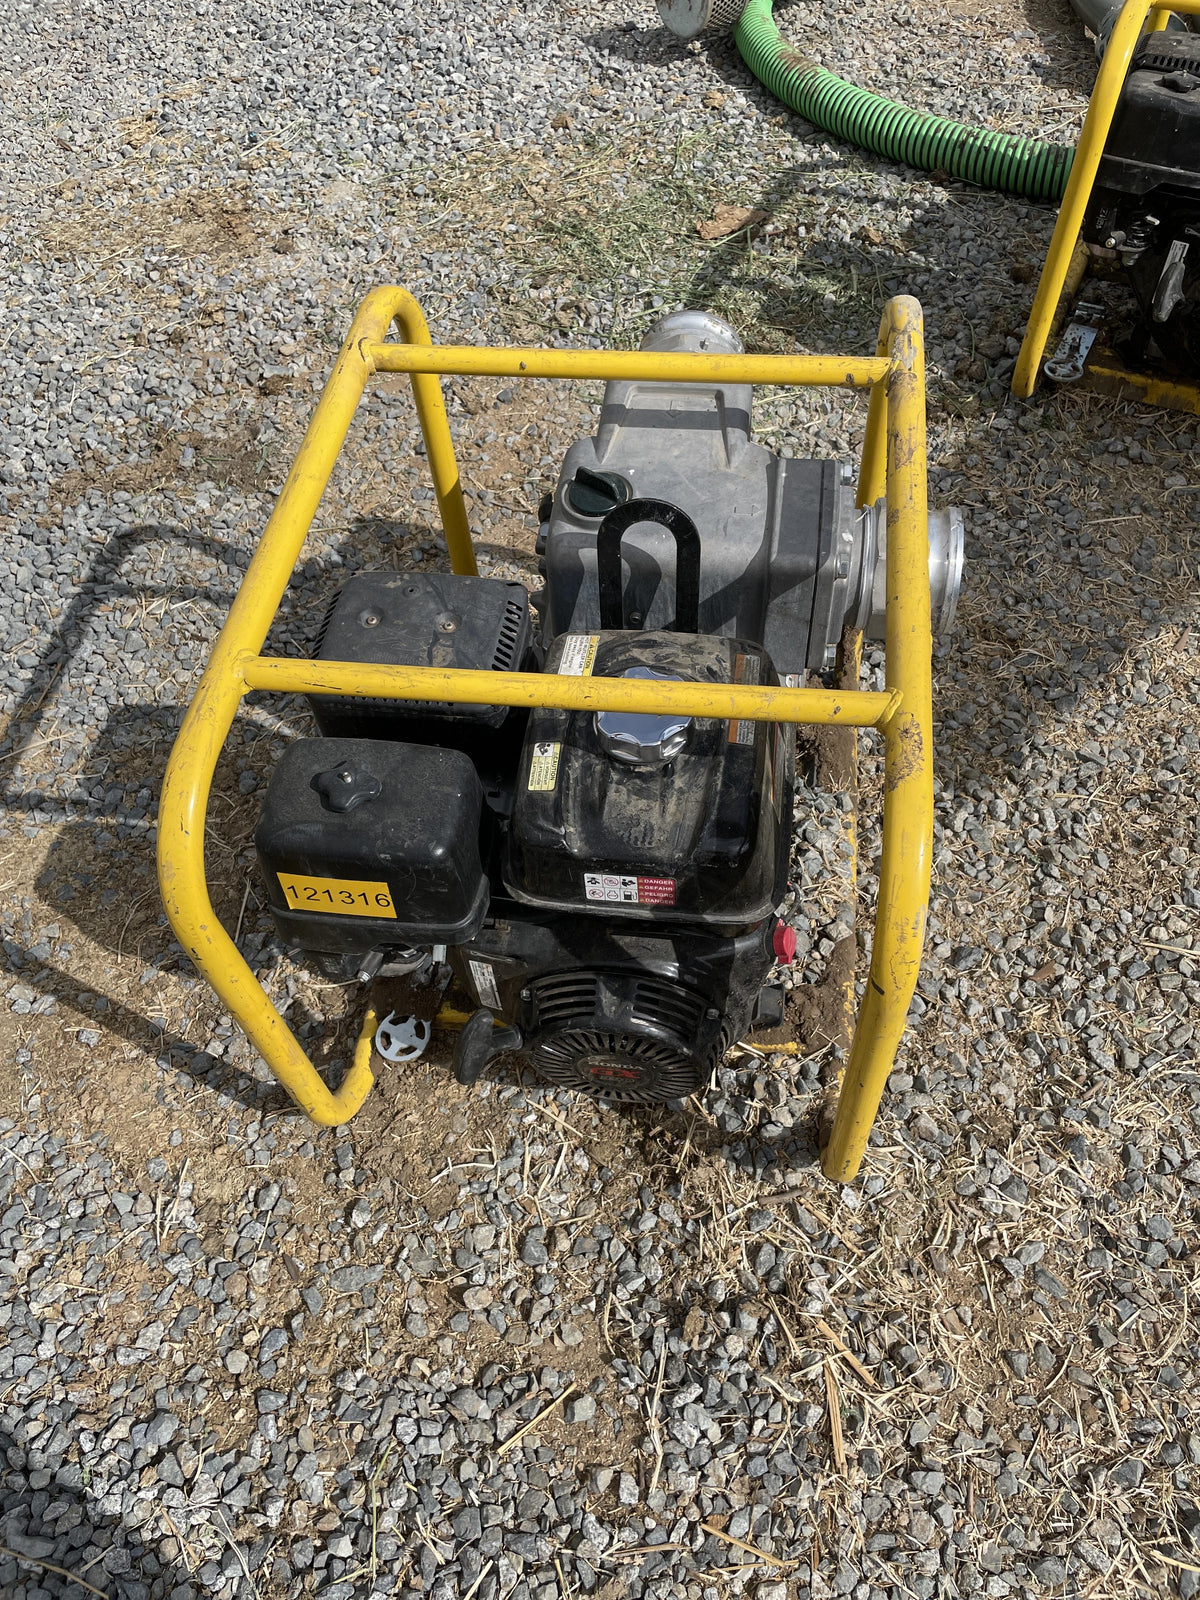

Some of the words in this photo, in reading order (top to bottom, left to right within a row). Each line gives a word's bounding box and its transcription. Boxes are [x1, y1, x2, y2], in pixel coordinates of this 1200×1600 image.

[287, 885, 391, 907] 121316
[588, 1062, 644, 1070] HONDA
[590, 1067, 641, 1078] GX
